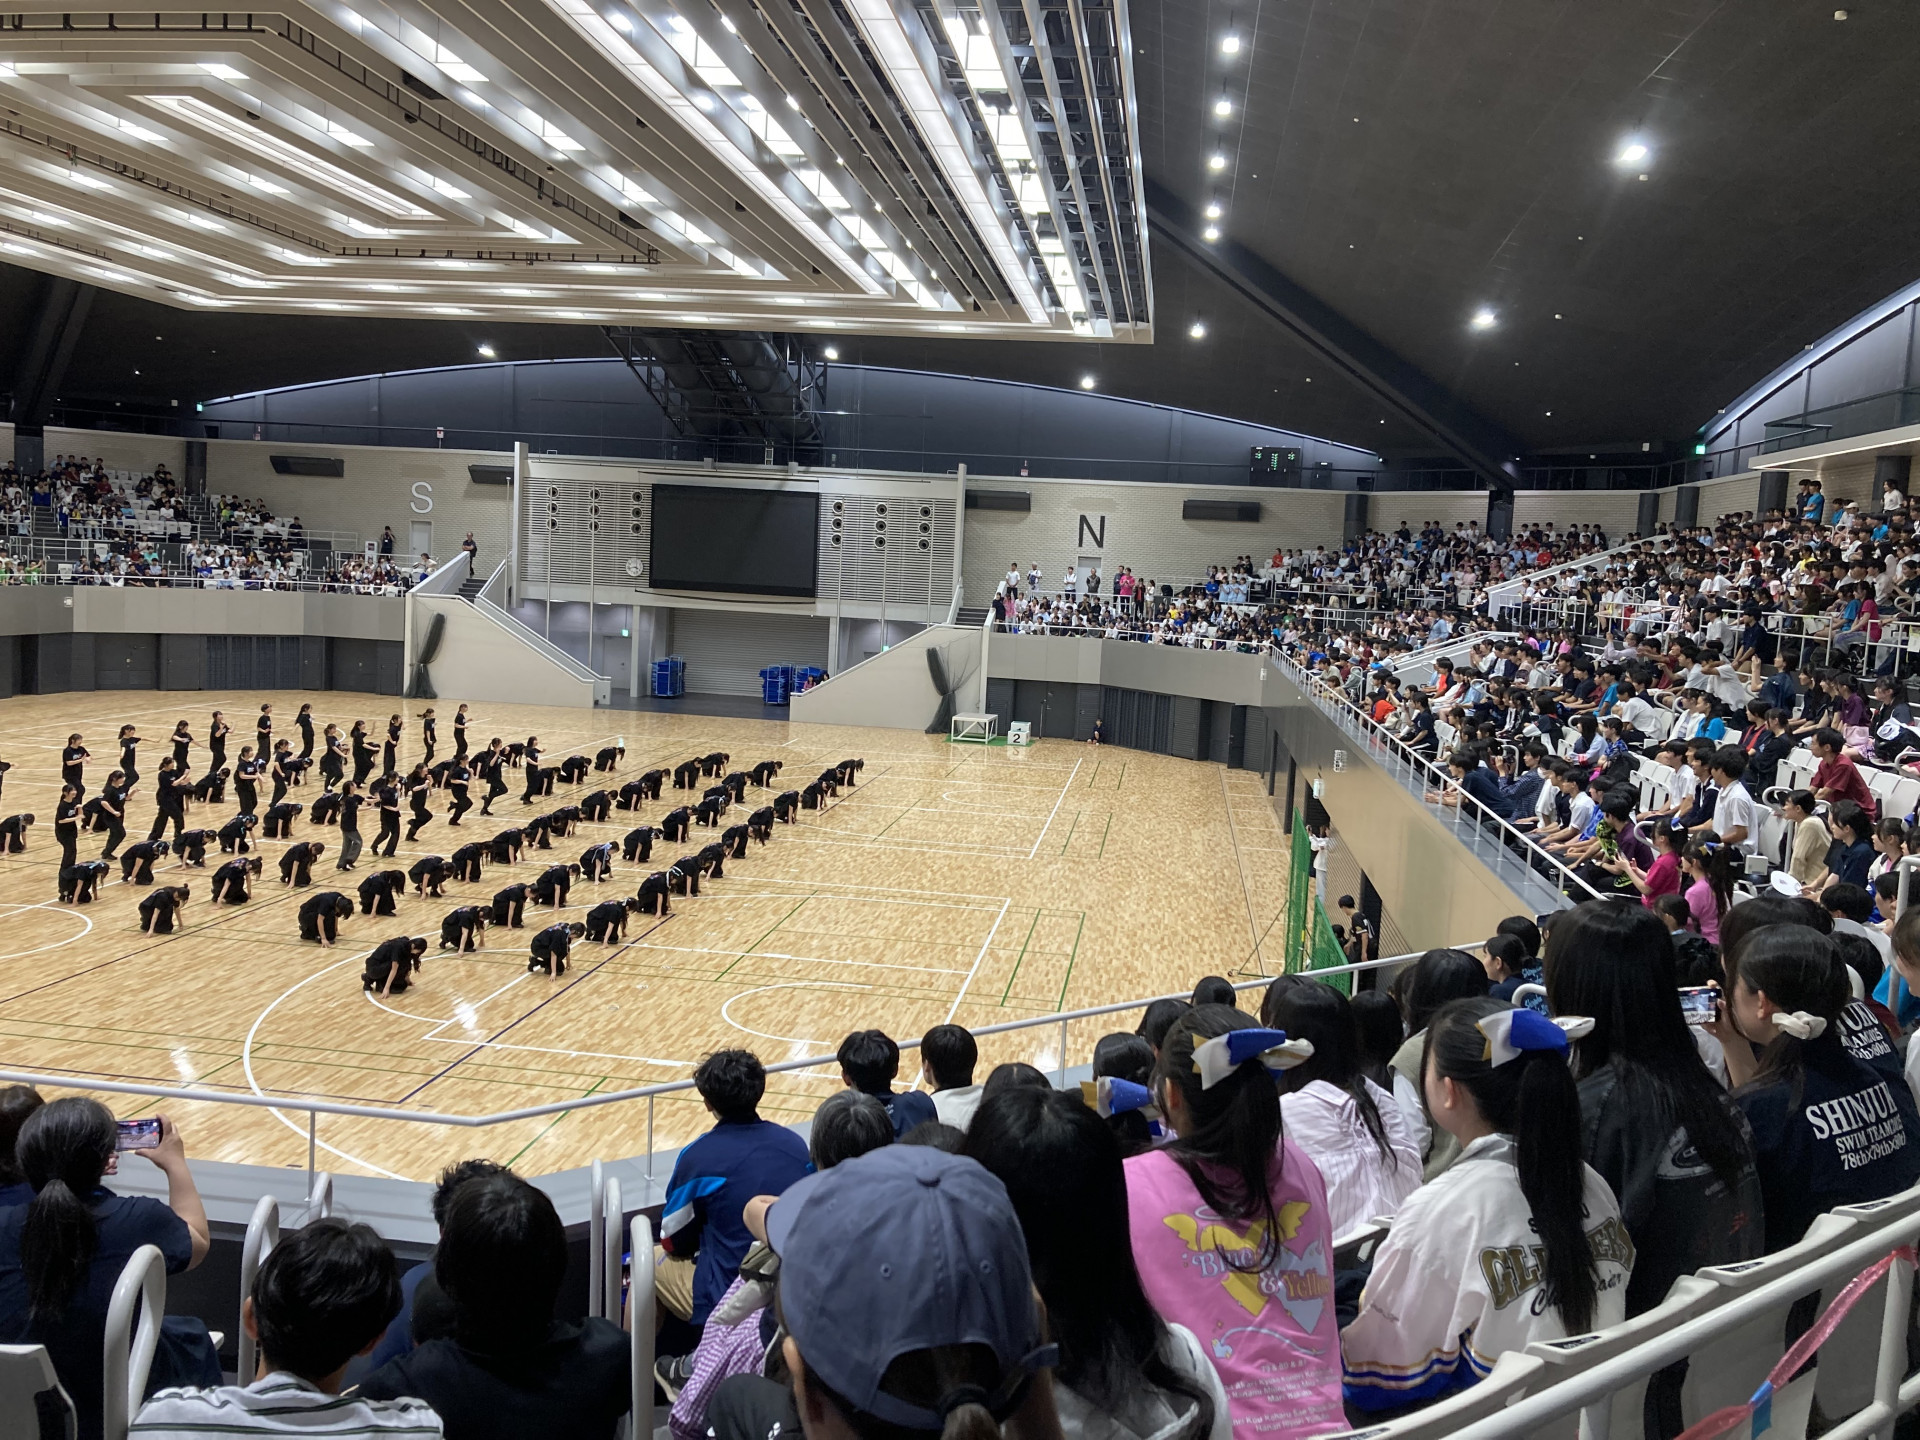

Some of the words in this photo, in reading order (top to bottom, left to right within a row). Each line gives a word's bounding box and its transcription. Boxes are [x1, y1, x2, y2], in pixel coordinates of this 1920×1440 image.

[410, 481, 433, 514] S
[1078, 514, 1106, 548] N
[1013, 733, 1021, 744] 2
[1836, 1130, 1868, 1153] SWIM
[1192, 1244, 1254, 1277] Blue
[1260, 1270, 1277, 1294] &
